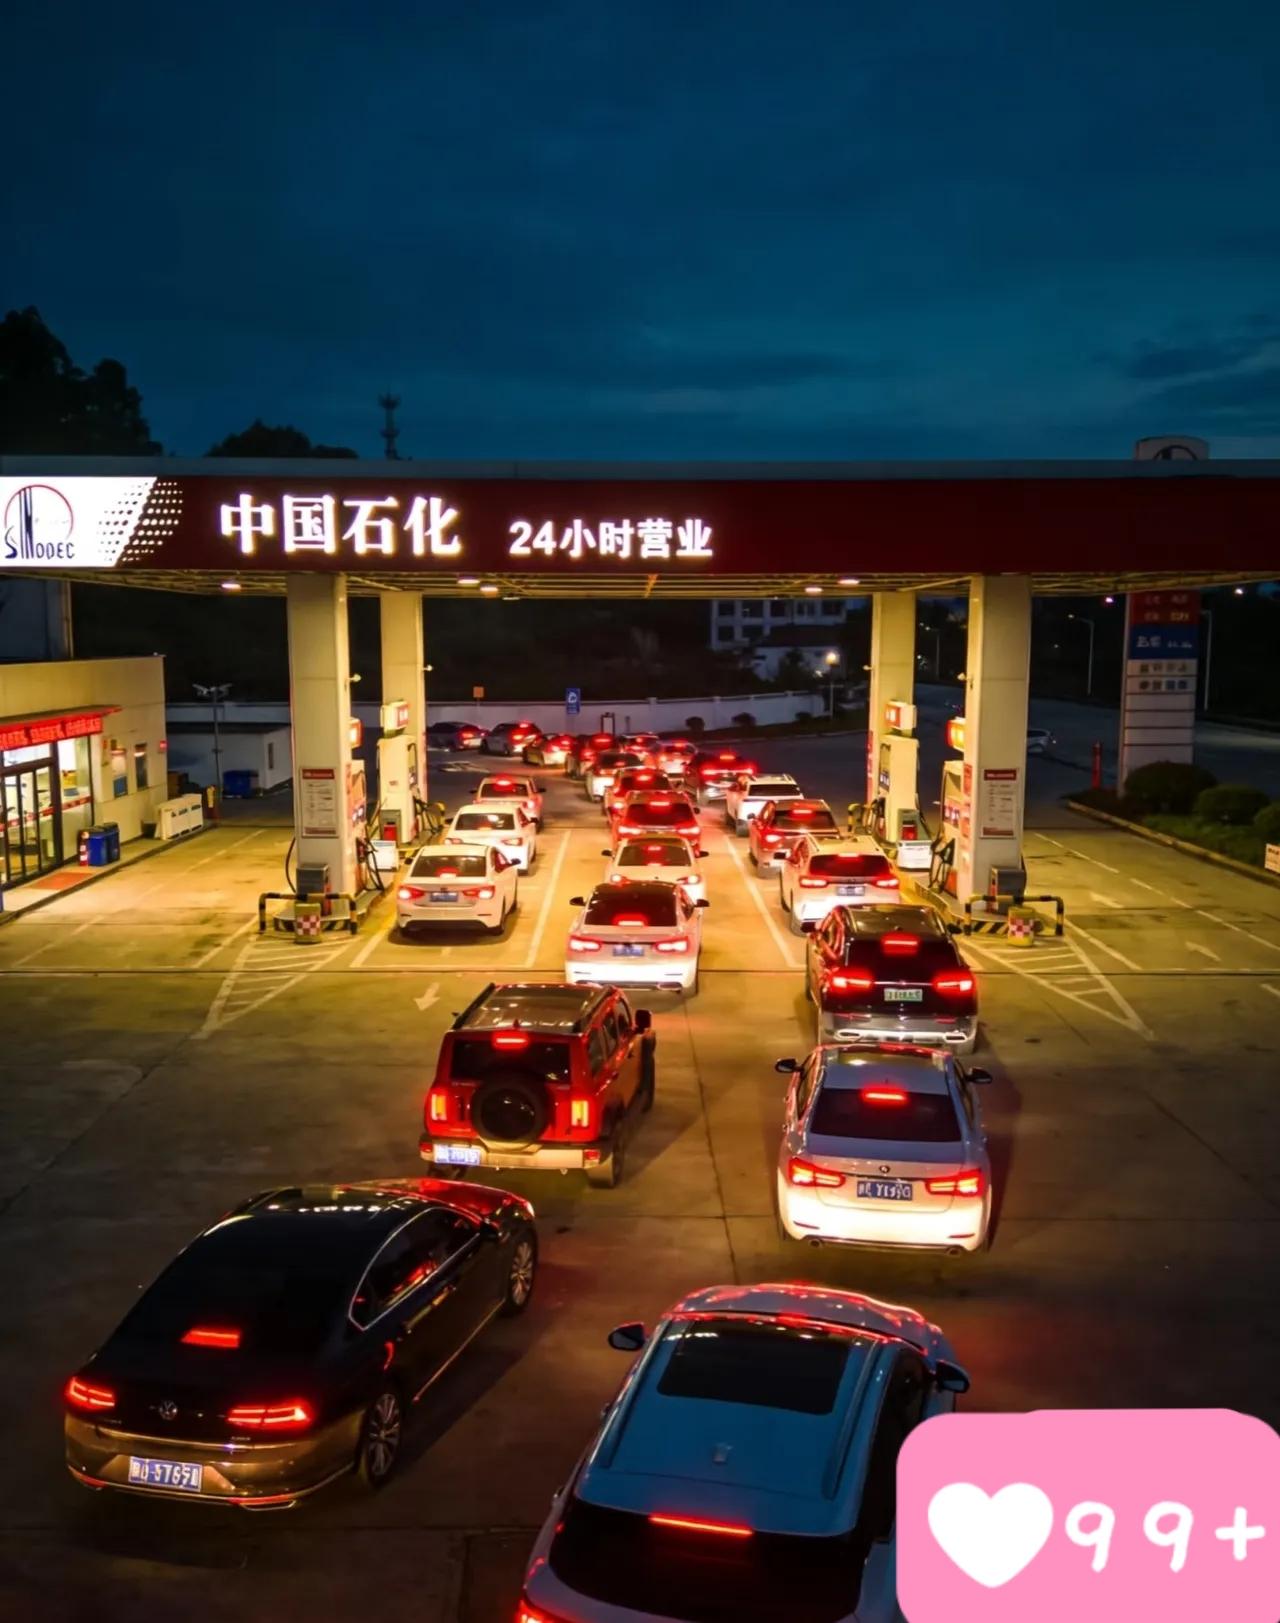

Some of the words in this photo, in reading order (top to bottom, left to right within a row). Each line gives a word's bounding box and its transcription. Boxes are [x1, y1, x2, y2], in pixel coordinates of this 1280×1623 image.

[220, 493, 462, 555] 中国石化
[509, 518, 714, 558] 24小时营业
